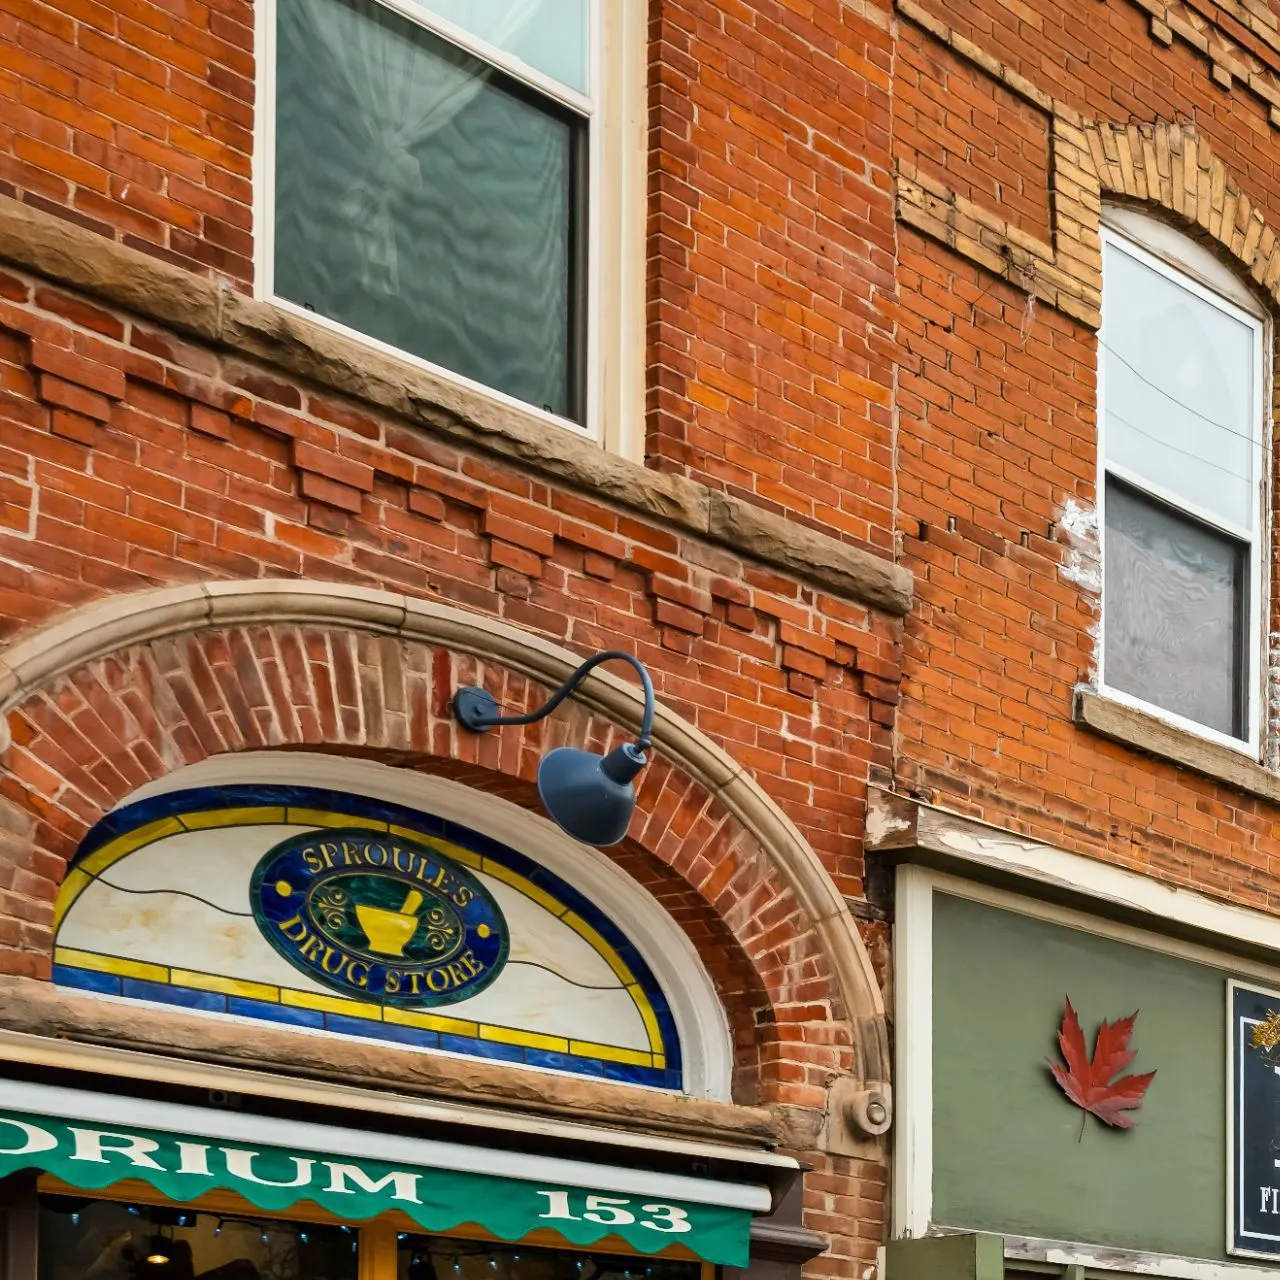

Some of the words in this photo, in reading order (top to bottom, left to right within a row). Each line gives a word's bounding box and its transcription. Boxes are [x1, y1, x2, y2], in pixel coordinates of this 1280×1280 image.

[302, 841, 474, 907] SPROULE'S
[279, 915, 368, 986] DRUG
[385, 950, 484, 994] STORE
[536, 1190, 693, 1234] 153
